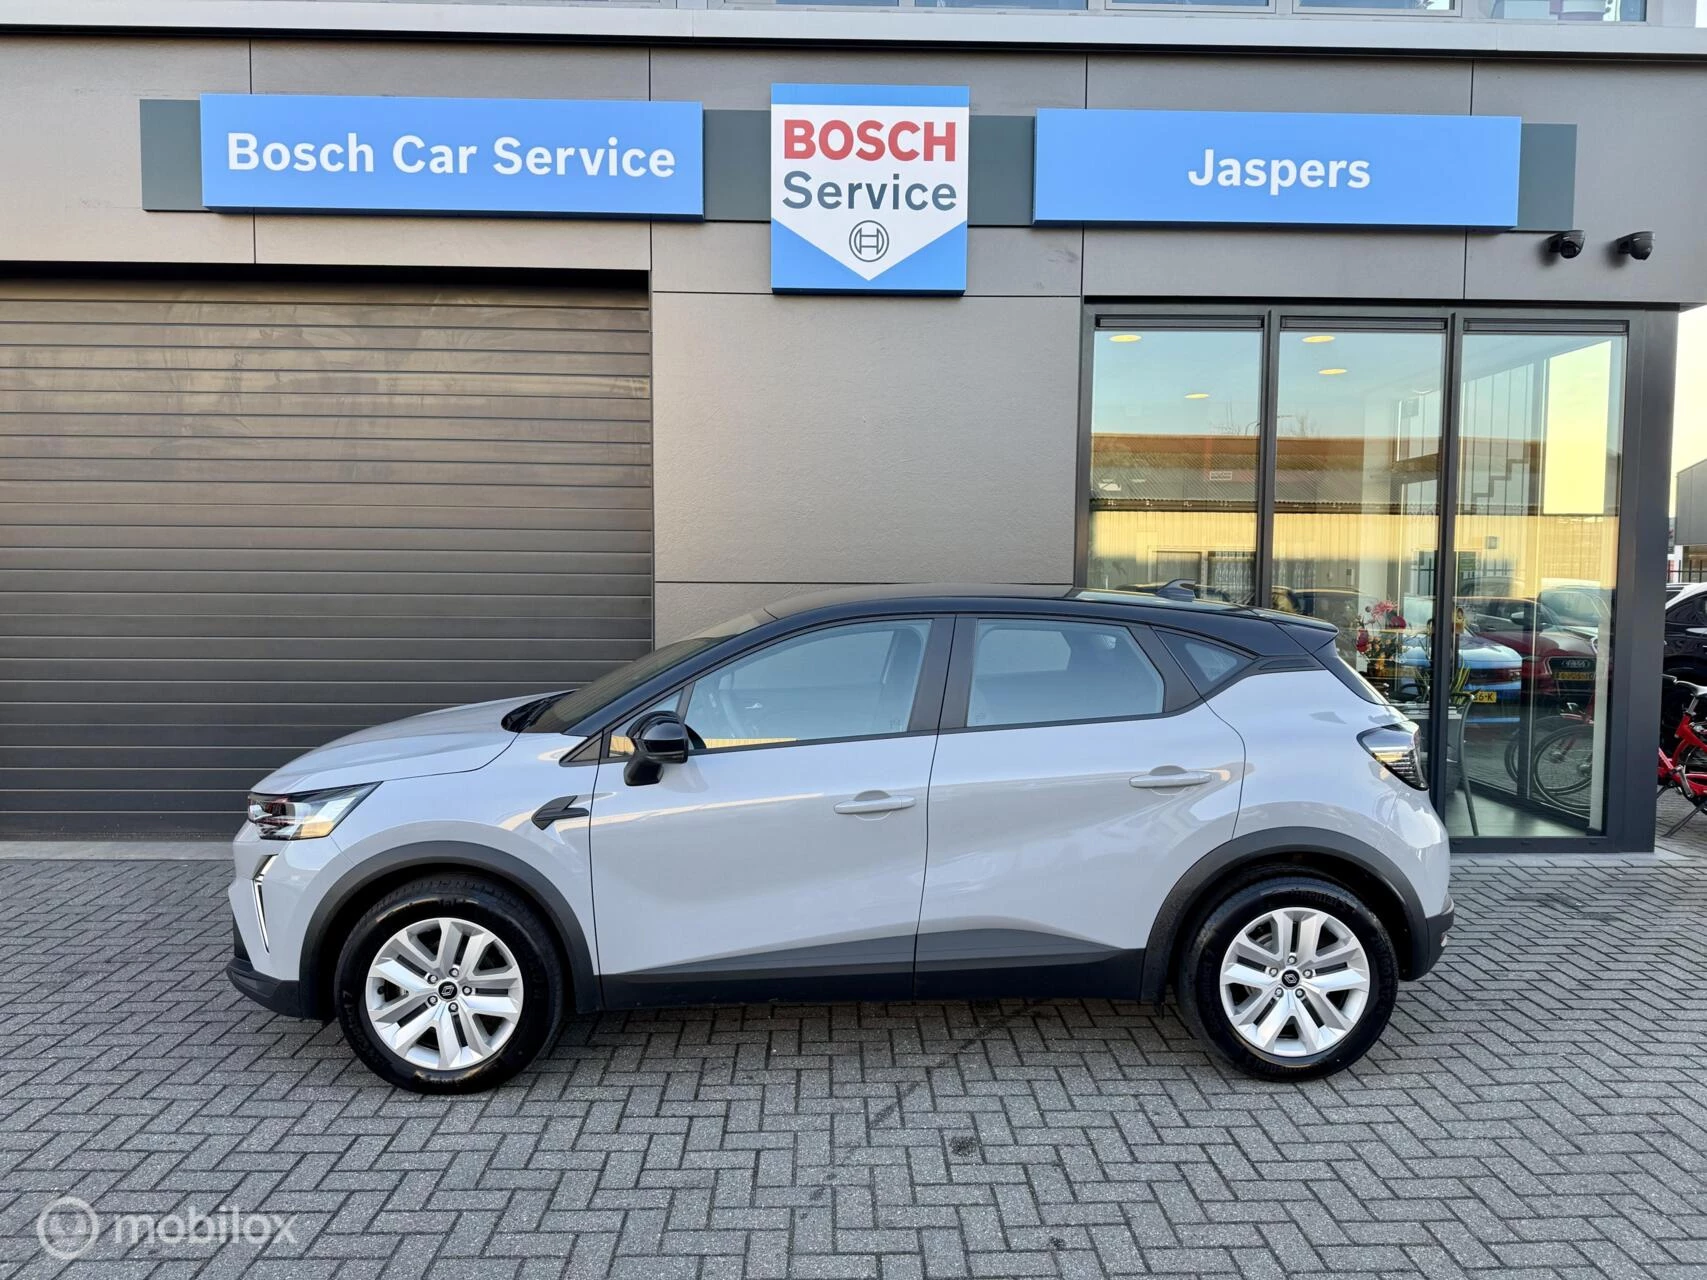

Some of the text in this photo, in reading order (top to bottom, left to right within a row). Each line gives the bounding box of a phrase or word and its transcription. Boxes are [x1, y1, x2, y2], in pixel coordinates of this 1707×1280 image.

[228, 132, 676, 178] Bosch Car Service
[783, 119, 957, 162] BOSCH
[782, 170, 957, 212] Service
[1188, 148, 1371, 196] Jaspers
